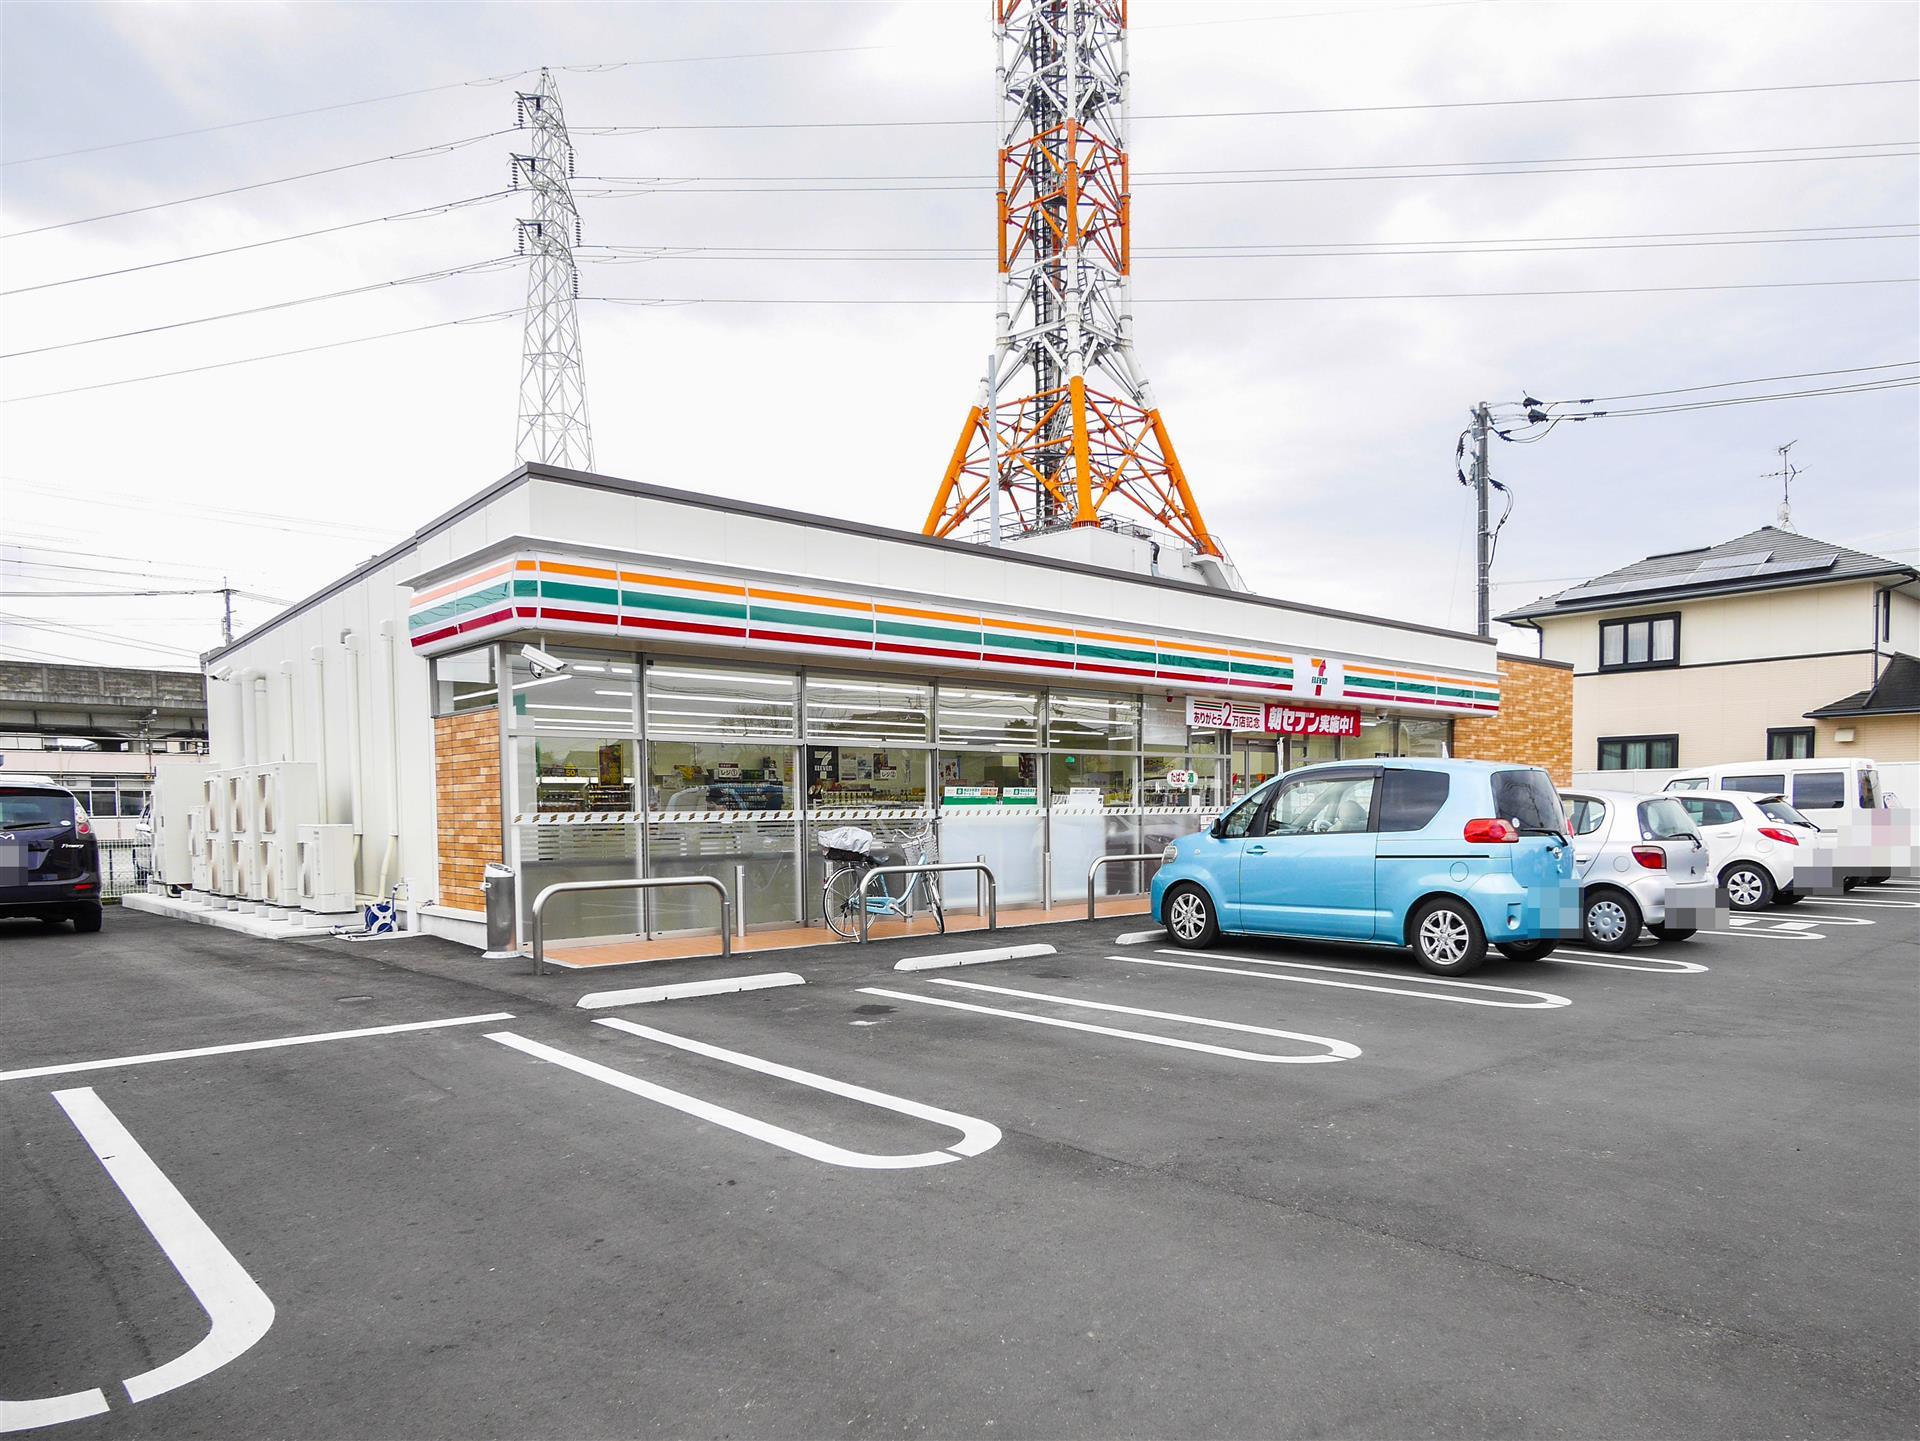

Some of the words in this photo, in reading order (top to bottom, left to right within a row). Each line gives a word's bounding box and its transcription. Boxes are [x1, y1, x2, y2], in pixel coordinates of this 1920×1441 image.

[1193, 702, 1260, 729] ありがとう2万店記念
